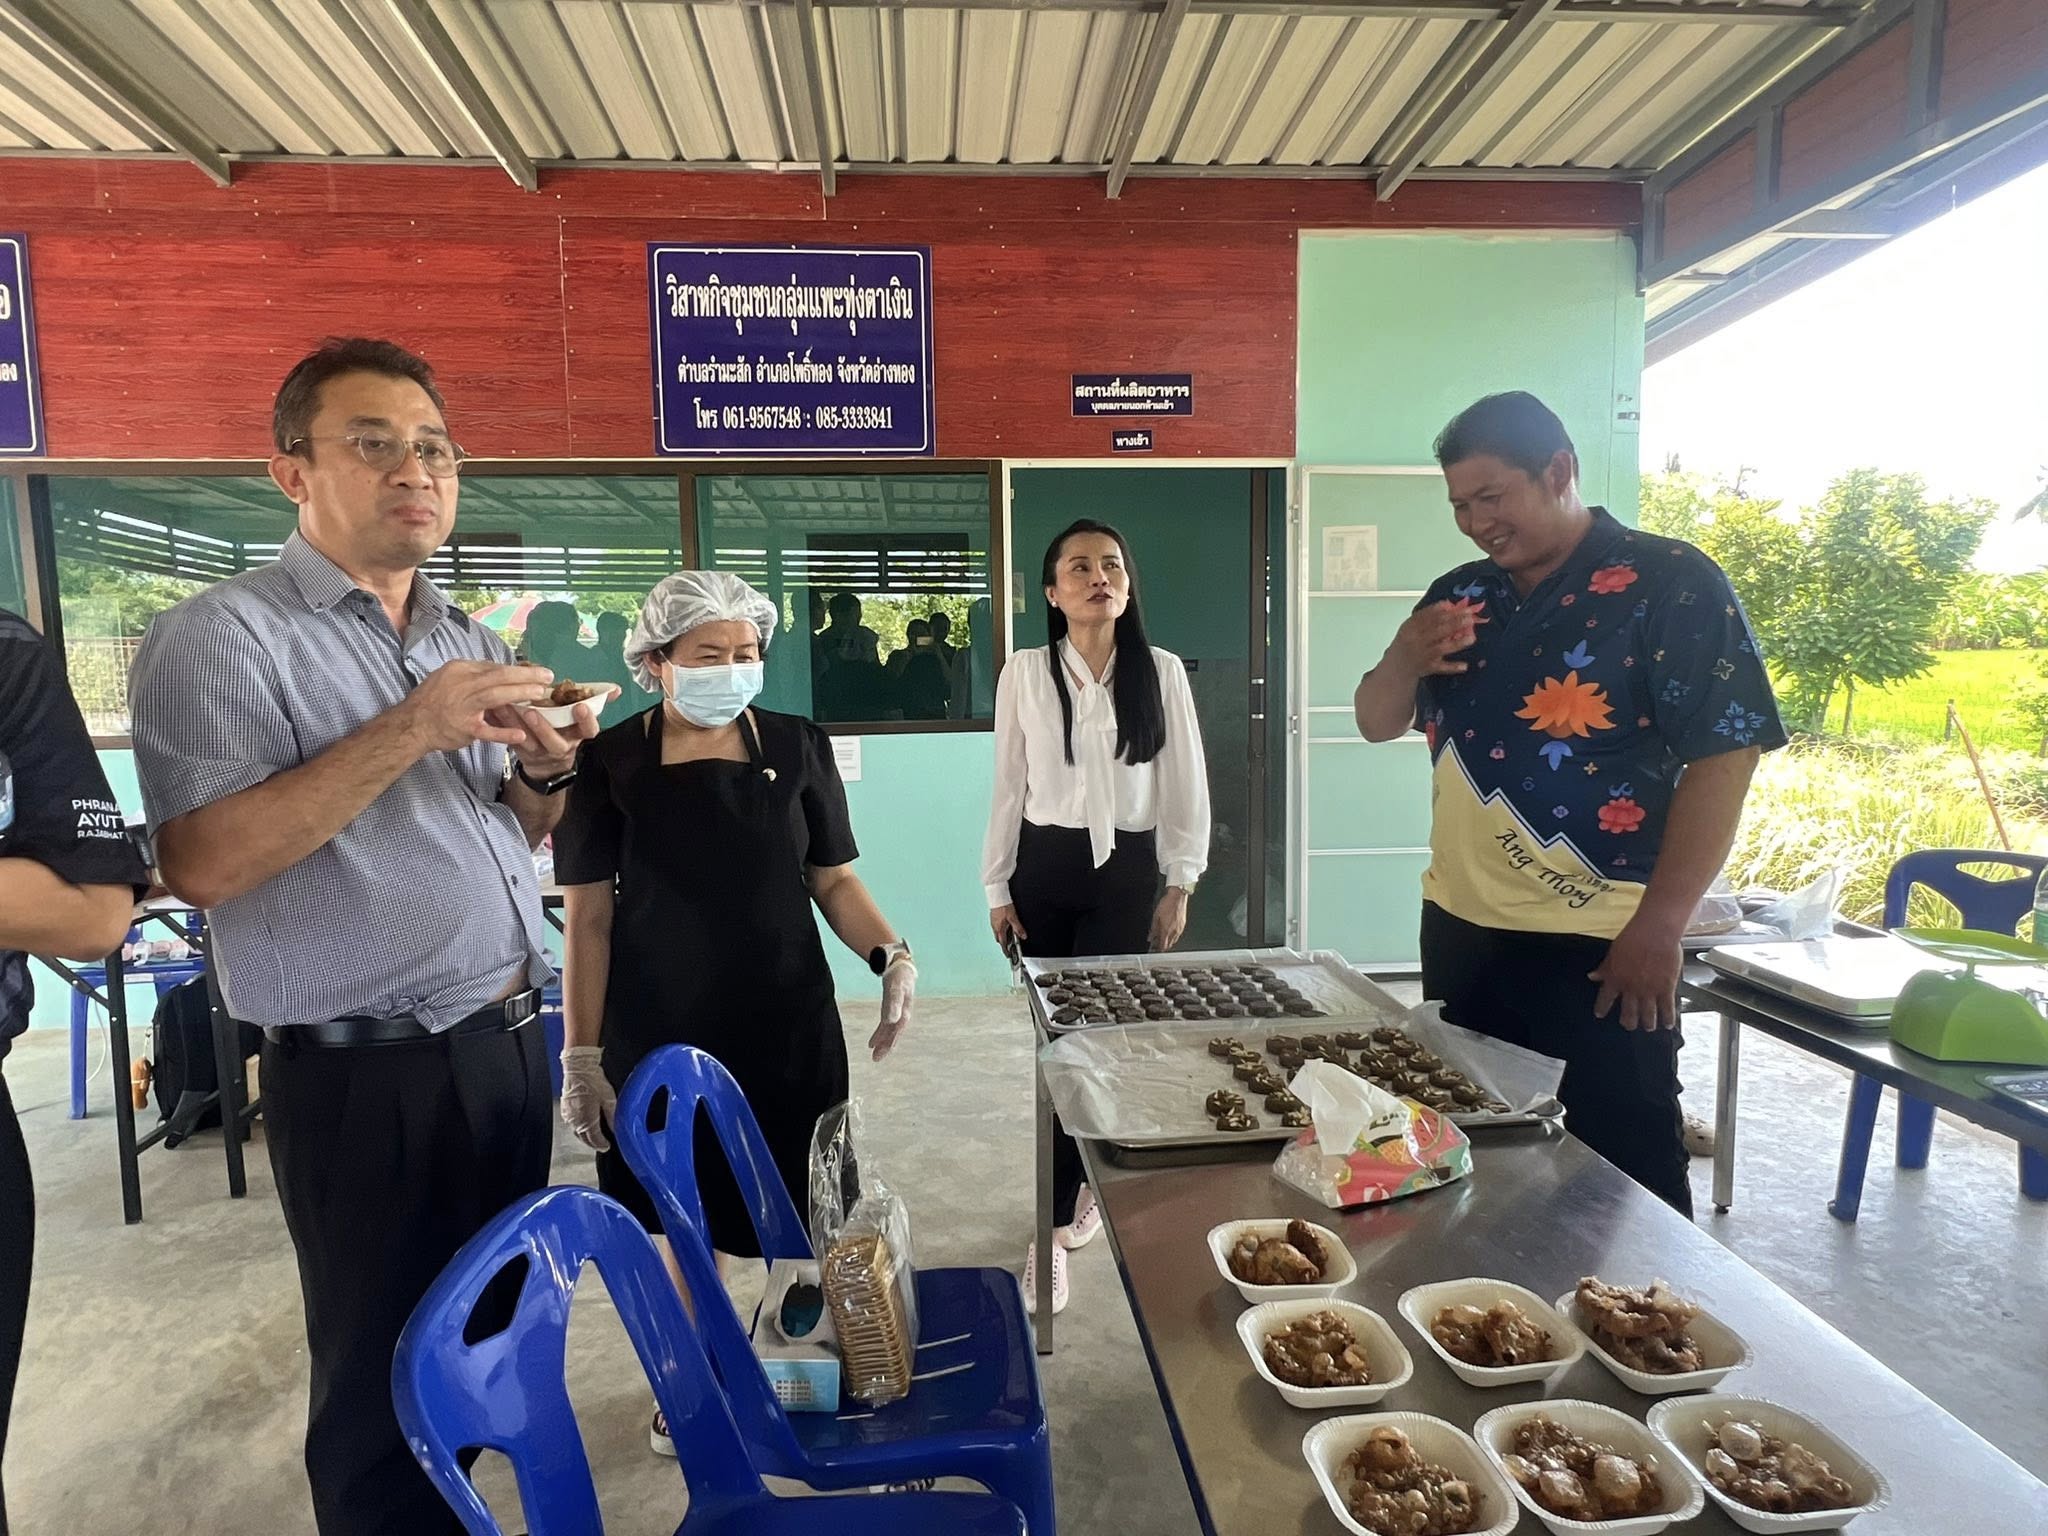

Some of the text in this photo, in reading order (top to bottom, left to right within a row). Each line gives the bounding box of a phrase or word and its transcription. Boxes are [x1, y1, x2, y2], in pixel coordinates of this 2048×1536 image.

[666, 273, 914, 336] วิสาหกิจชุมชนกลุ่มแพะทุ่งตาเงิน
[677, 346, 915, 384] ตำบลรำมะสัก อำเภอโพธิ์ทอง จังหวัดอ่างทอง
[1075, 377, 1190, 398] สถานที่ผลิตอาหาร
[693, 397, 718, 429] โทร
[722, 405, 802, 429] 061-9567548
[815, 406, 893, 429] 085-3333841
[1115, 433, 1149, 447] ทางเข้า
[1495, 828, 1534, 869] Ang
